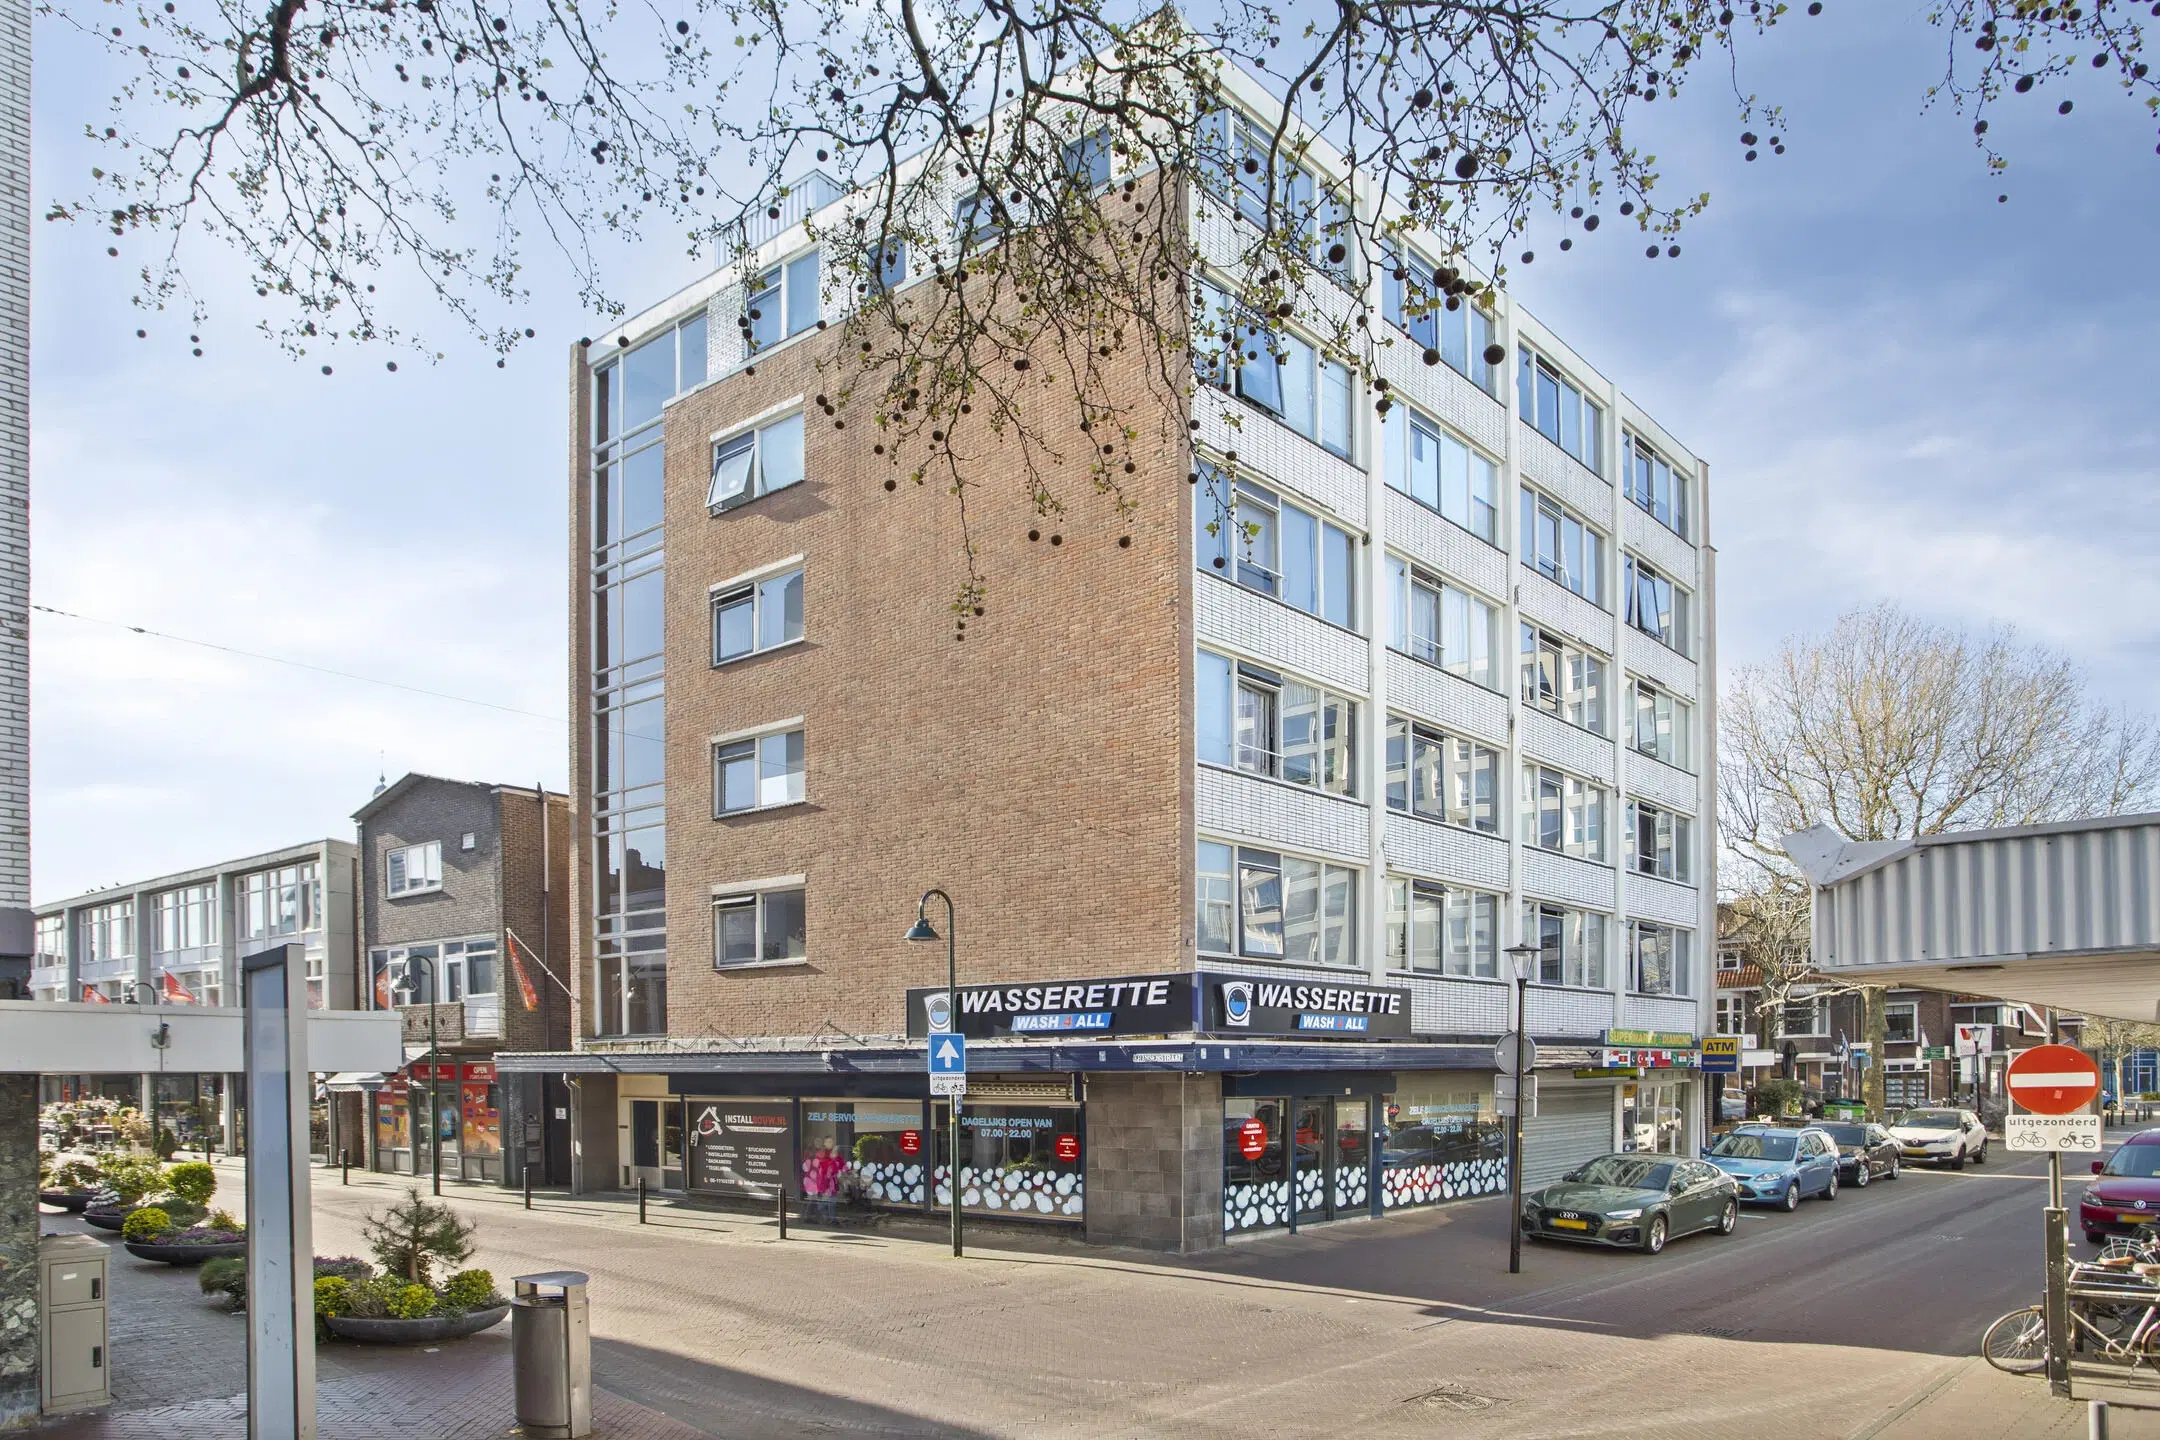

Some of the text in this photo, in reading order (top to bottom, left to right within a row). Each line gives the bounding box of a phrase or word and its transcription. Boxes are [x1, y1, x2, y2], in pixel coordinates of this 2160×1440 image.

[961, 981, 1170, 1013] WASSERETTE
[1259, 984, 1401, 1014] WASSERETTE
[1016, 1014, 1104, 1029] WASH 4 ALL
[1303, 1016, 1364, 1030] WASH 4 ALL
[1706, 1042, 1733, 1051] ATM
[1409, 1106, 1424, 1115] ZELF
[808, 1112, 826, 1121] ZELF
[828, 1113, 862, 1122] SERVICE
[962, 1118, 1052, 1128] DAGELIJKS OPEN VAN
[2009, 1118, 2097, 1127] uitgezonderd
[981, 1129, 1003, 1137] 07.00
[1009, 1130, 1031, 1138] 22.00
